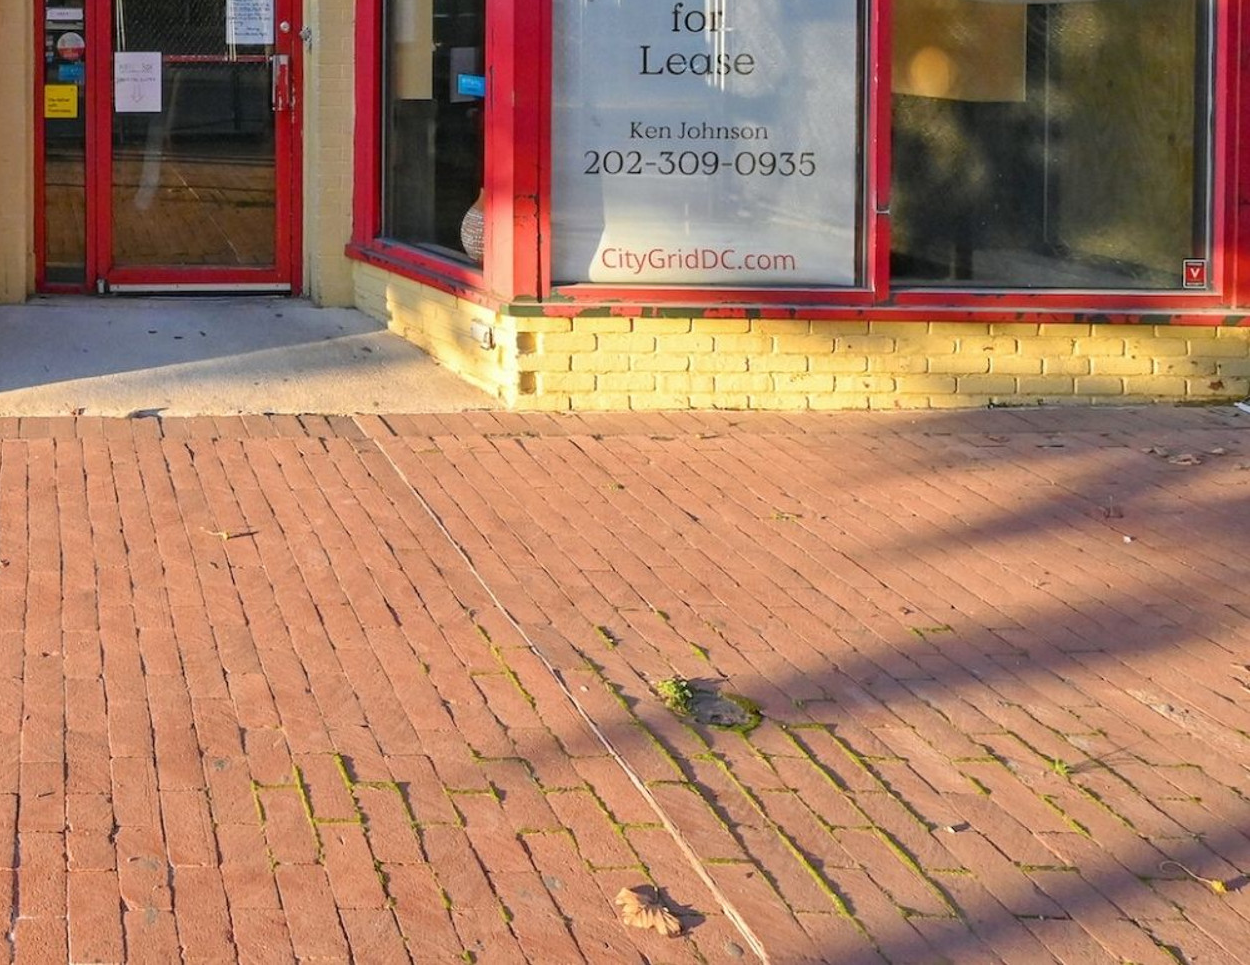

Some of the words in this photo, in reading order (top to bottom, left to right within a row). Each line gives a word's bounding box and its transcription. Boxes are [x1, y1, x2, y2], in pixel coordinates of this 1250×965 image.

[671, 2, 723, 32] for
[639, 45, 755, 75] Lease
[630, 121, 671, 139] Ken
[677, 122, 768, 139] Johnson
[583, 150, 816, 176] 202-309-0935
[602, 248, 796, 274] CityGridDC.com
